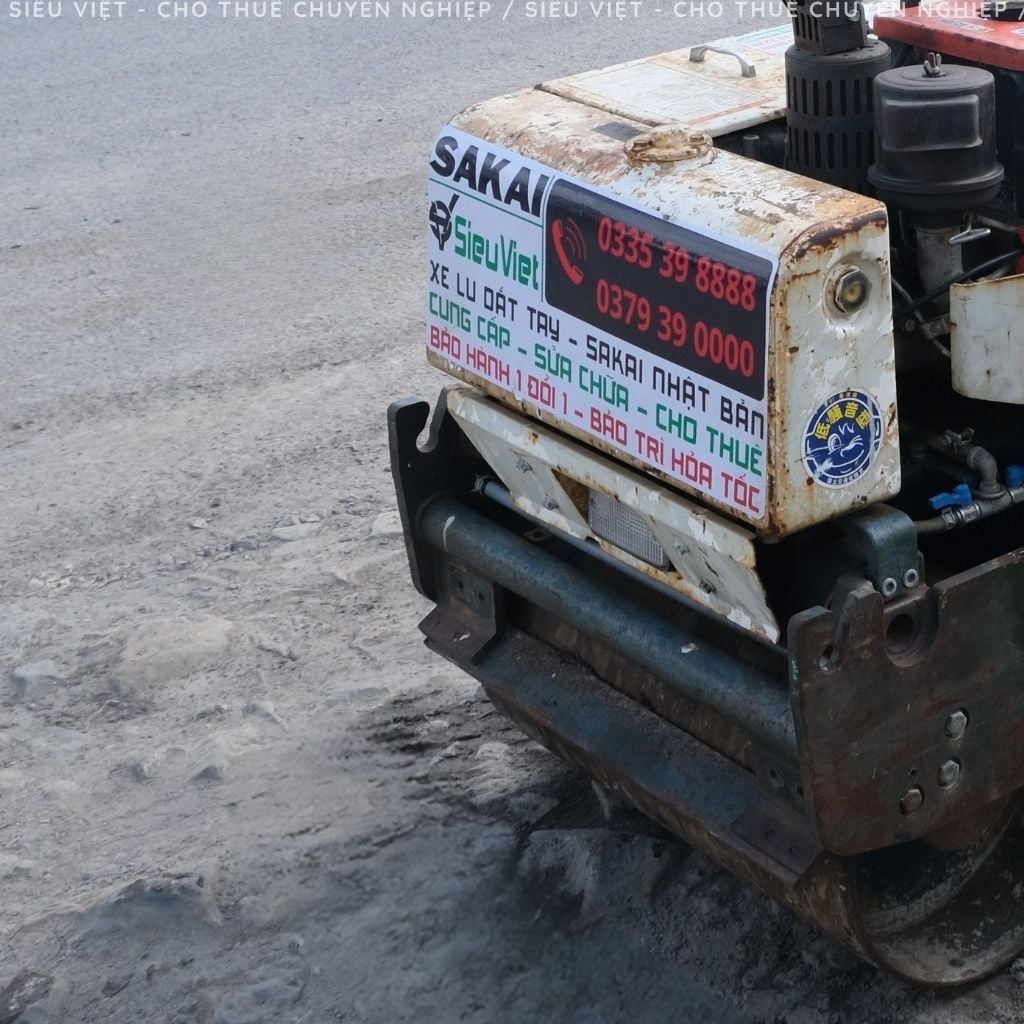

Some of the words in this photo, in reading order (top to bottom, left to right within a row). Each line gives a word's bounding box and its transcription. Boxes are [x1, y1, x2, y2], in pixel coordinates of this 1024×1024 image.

[429, 135, 550, 218] SAKAI
[598, 216, 654, 269] 0335
[659, 240, 689, 283] 39
[695, 256, 757, 312] 8888
[430, 260, 449, 289] XE
[457, 273, 476, 302] LU
[526, 306, 560, 342] TAY
[586, 334, 643, 384] SAKAI
[652, 365, 710, 413] NHẬT
[720, 396, 764, 440] BẢN
[596, 278, 651, 332] 0379
[657, 305, 688, 348] 39
[694, 321, 754, 377] 0000
[429, 291, 471, 333] CUNG
[477, 316, 511, 349] CẤP
[534, 342, 572, 383] SỬA
[578, 365, 629, 413] CHỮA
[656, 403, 697, 445] CHO
[706, 425, 763, 476] THUÊ
[430, 324, 461, 360] BẢO
[466, 343, 510, 386] HÀNH
[516, 368, 522, 392] 1
[562, 391, 568, 415] 1
[590, 406, 628, 447] BẢO
[634, 429, 664, 466] TRÌ
[671, 448, 713, 490] HỎA
[720, 470, 760, 514] TỐC
[814, 401, 872, 440] 低騒音型
